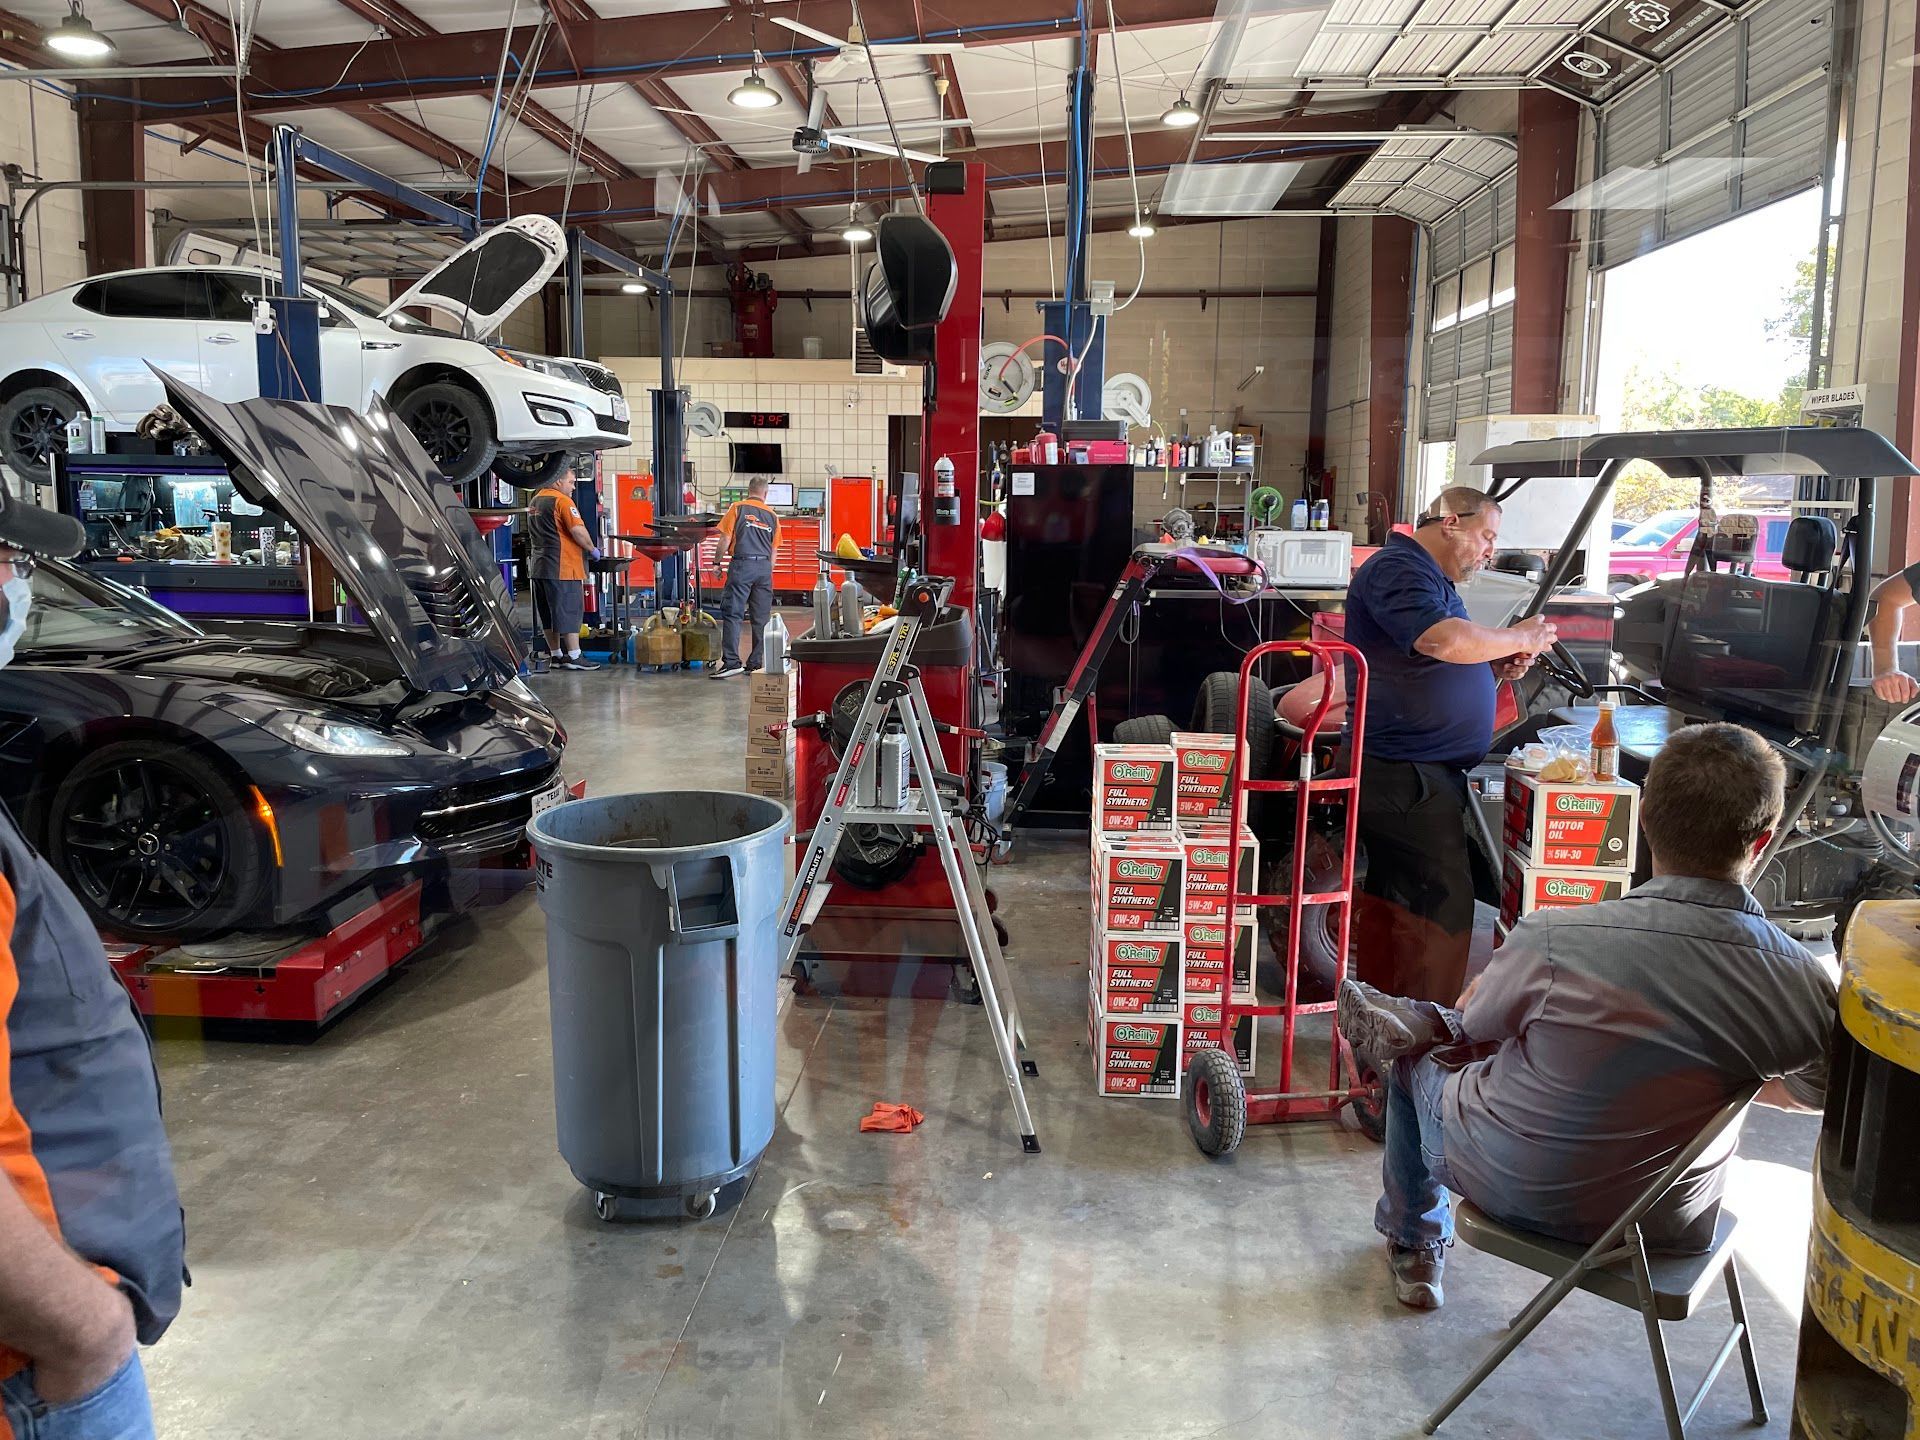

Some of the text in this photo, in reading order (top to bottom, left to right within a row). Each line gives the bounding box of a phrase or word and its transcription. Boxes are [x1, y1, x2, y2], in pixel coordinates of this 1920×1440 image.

[1811, 391, 1855, 404] WIPER BLADES
[751, 414, 764, 426] 73
[1183, 751, 1225, 769] O'Reilly
[1113, 764, 1154, 780] O'Reilly
[1180, 776, 1199, 784] FULL
[1108, 788, 1128, 797] FULL
[1178, 784, 1220, 794] SYNTHETIC
[1105, 797, 1149, 807] SYNTHETIC
[1180, 802, 1204, 812] 5W-20
[1557, 796, 1604, 813] O'Reilly
[1108, 815, 1134, 826] 0W-20
[1549, 821, 1584, 831] MOTOR
[1549, 831, 1564, 840] OIL
[1554, 849, 1582, 860] 5W-30
[1118, 861, 1162, 879] O'Reilly
[1188, 874, 1208, 882] FULL
[1113, 887, 1134, 895] FULL
[1186, 882, 1228, 891] SYNTHETIC
[1546, 881, 1594, 899] O'Reilly
[1111, 895, 1155, 905] SYNTHETIC
[1188, 900, 1213, 911] 5W-20
[1113, 914, 1139, 924] 0W-20
[1193, 928, 1225, 943] O'Reill
[1116, 945, 1160, 961] O'Reilly
[1187, 951, 1206, 959] FULL
[1185, 960, 1224, 969] SYNTHETI
[1112, 970, 1132, 978] FULL
[1110, 979, 1154, 988] SYNTHETIC
[1186, 978, 1211, 988] 5W-20
[1113, 997, 1139, 1007] 0W-20
[1113, 1025, 1158, 1042] O'Reilly
[1186, 1040, 1220, 1048] SYNTHET
[1110, 1051, 1130, 1059] FULL
[1108, 1060, 1151, 1069] SYNTHETIC
[1111, 1078, 1137, 1088] 0W-20
